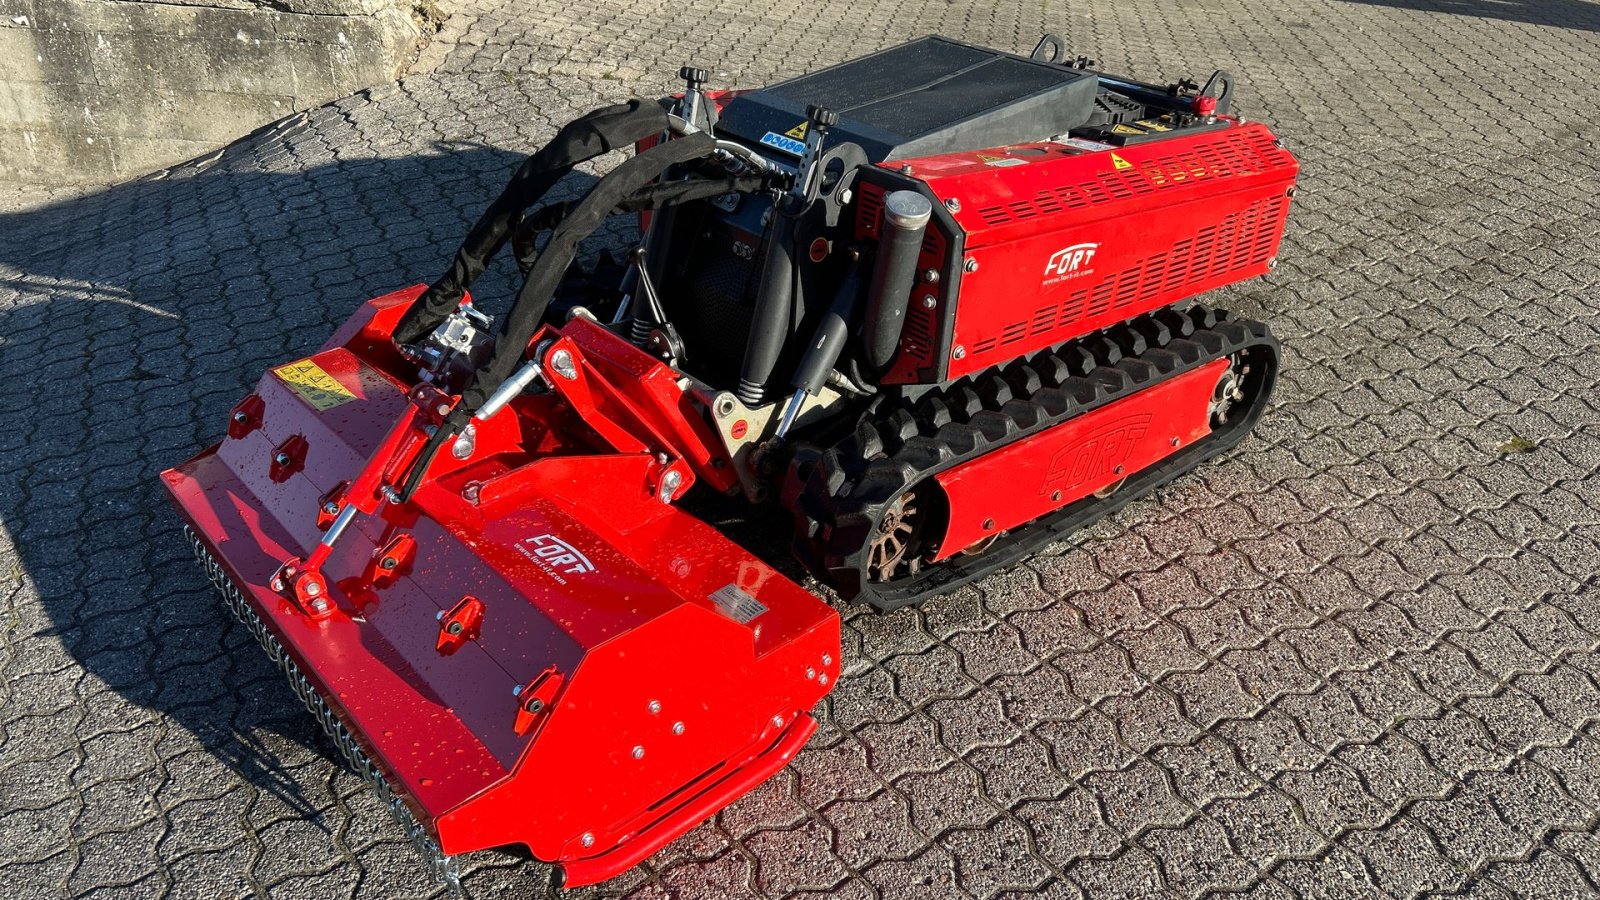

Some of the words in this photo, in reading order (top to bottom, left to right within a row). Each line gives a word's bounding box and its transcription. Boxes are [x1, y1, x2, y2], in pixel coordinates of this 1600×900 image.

[1044, 242, 1098, 275] FORT
[1039, 413, 1152, 495] FORT
[525, 534, 596, 574] FORT
